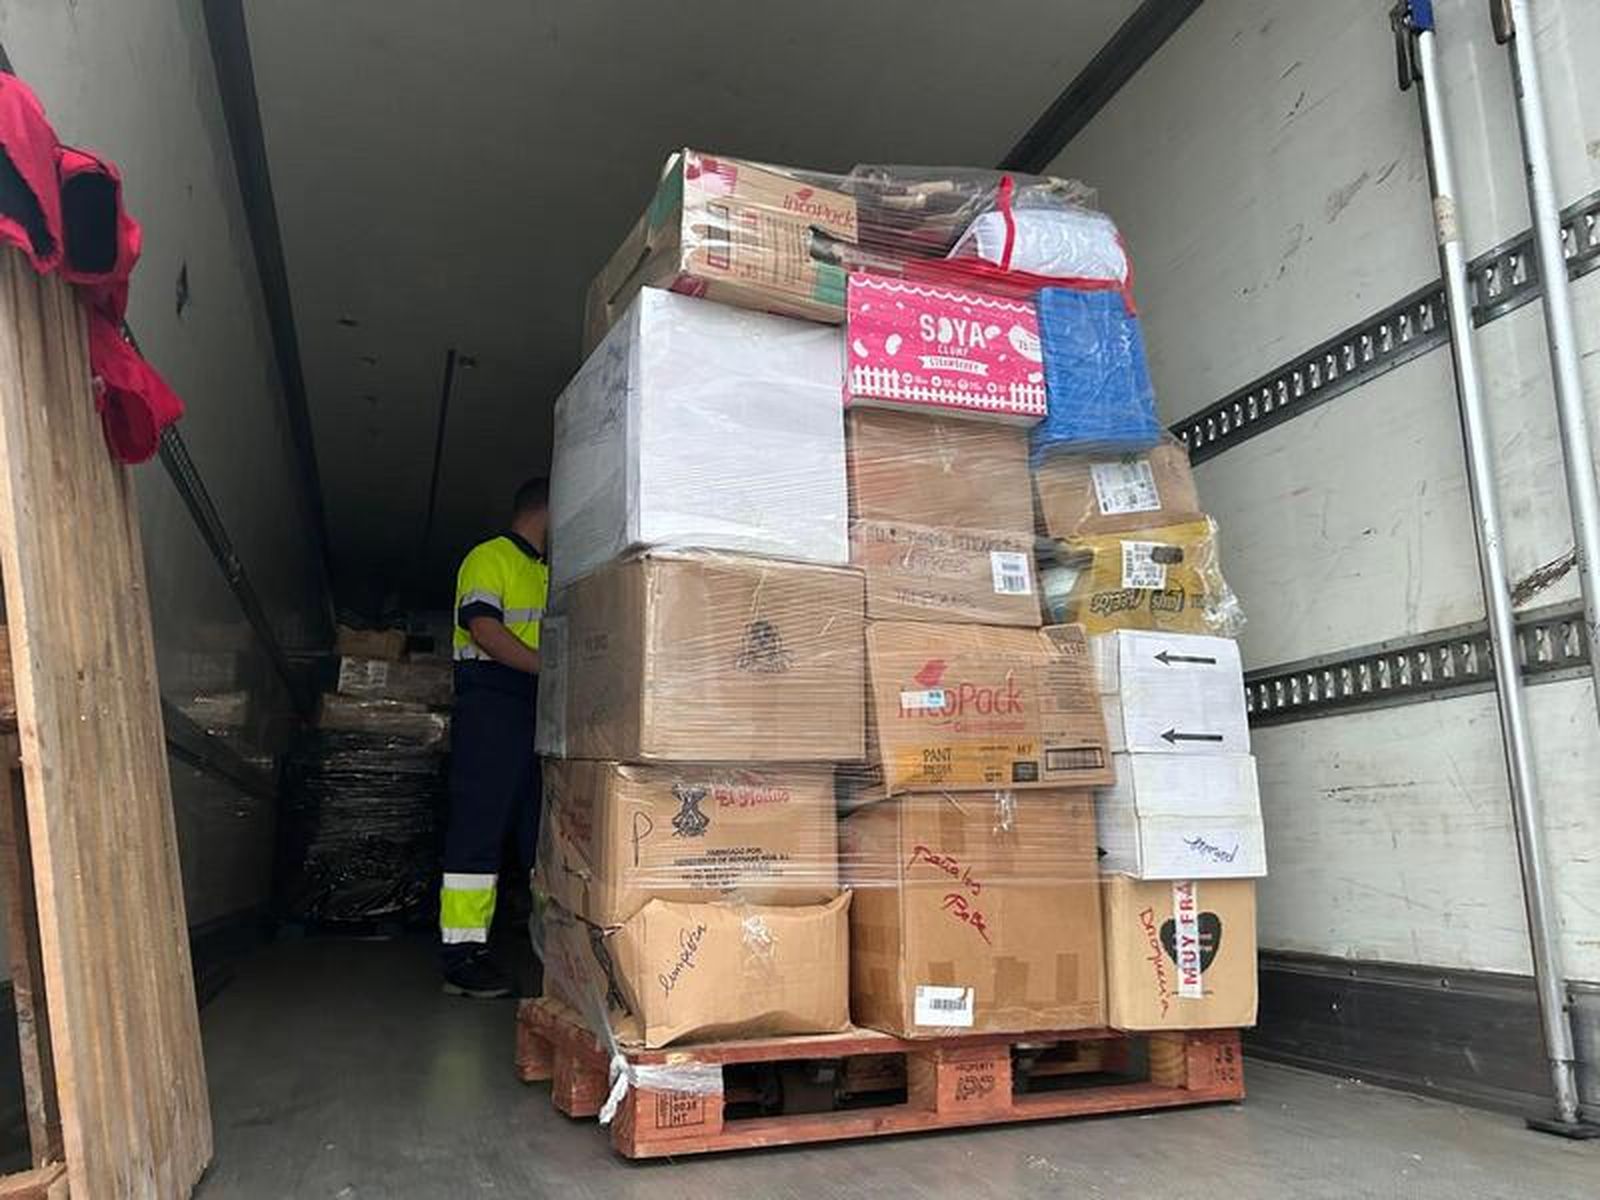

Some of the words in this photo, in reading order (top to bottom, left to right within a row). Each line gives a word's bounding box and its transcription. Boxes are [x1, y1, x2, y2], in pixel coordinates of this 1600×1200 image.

[919, 313, 987, 349] SOYA
[922, 747, 953, 763] PANT
[1181, 935, 1199, 985] MUY
